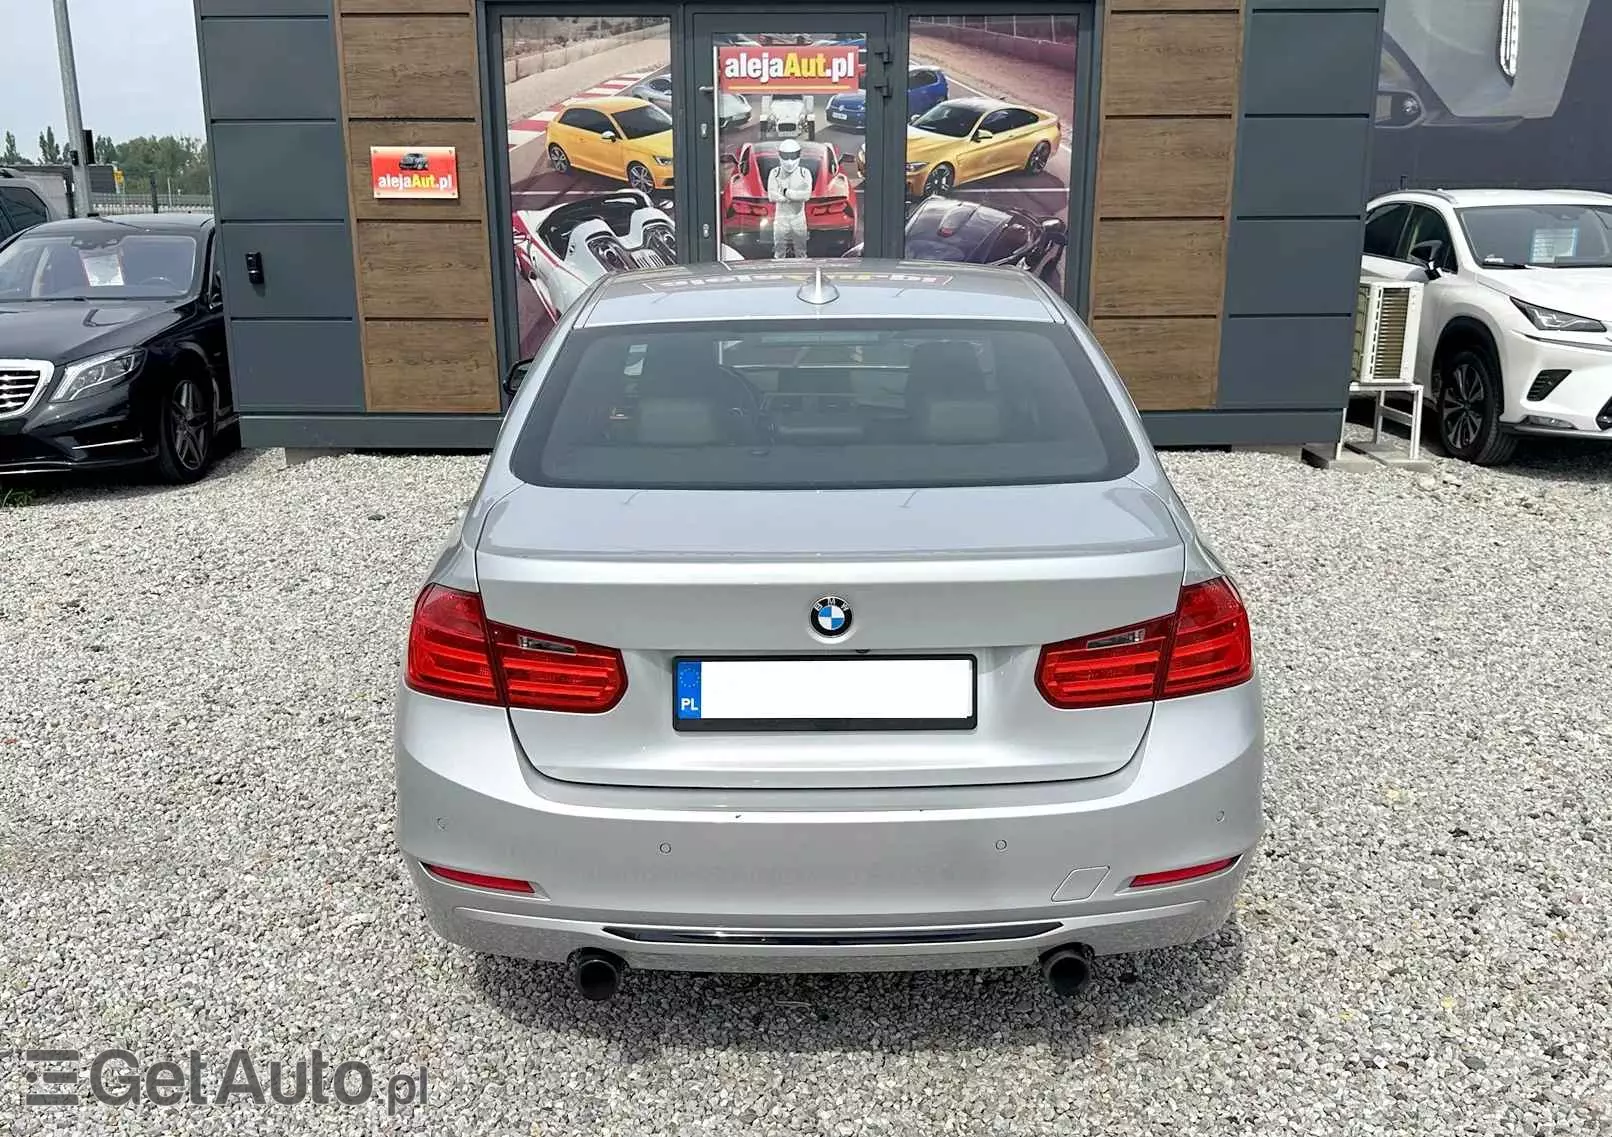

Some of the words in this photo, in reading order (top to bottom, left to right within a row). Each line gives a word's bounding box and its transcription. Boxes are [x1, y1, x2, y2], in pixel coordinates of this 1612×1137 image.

[724, 52, 855, 83] alejaAut.pl
[378, 173, 453, 190] alejaAut.pl
[813, 597, 849, 611] BMW
[680, 697, 699, 711] PL
